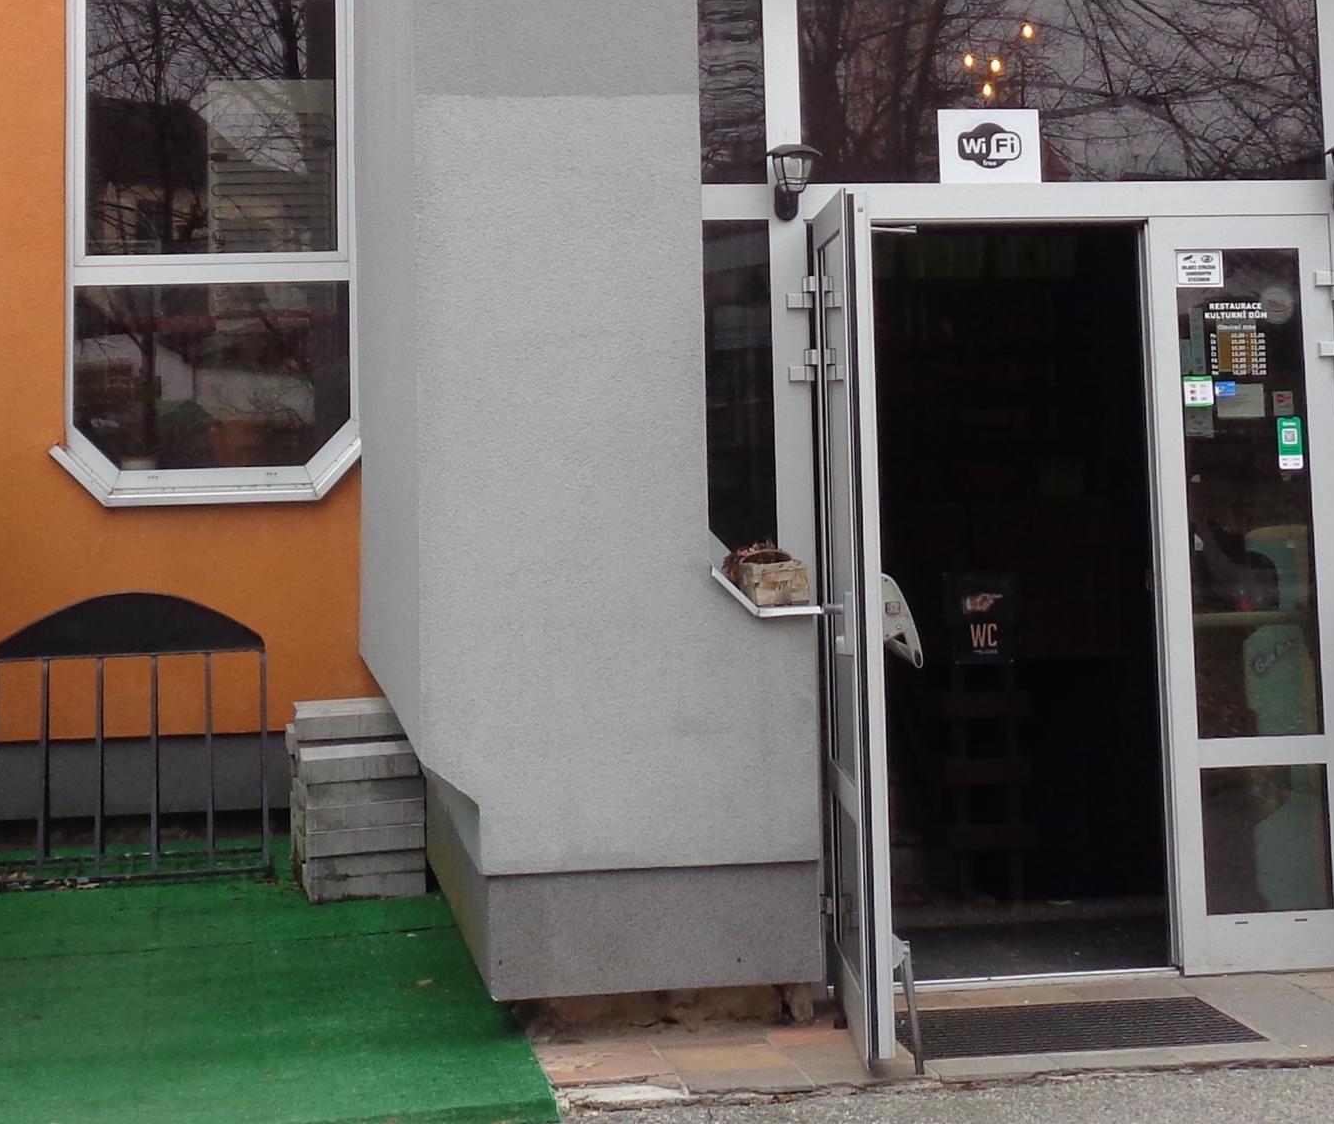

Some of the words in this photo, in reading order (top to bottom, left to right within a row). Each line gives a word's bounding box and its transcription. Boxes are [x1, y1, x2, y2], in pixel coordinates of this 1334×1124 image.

[983, 159, 997, 167] free
[1208, 302, 1262, 310] RESTAURACE
[1204, 310, 1247, 319] KULTURNÍ
[1248, 309, 1268, 319] DŮM
[970, 623, 998, 647] WC
